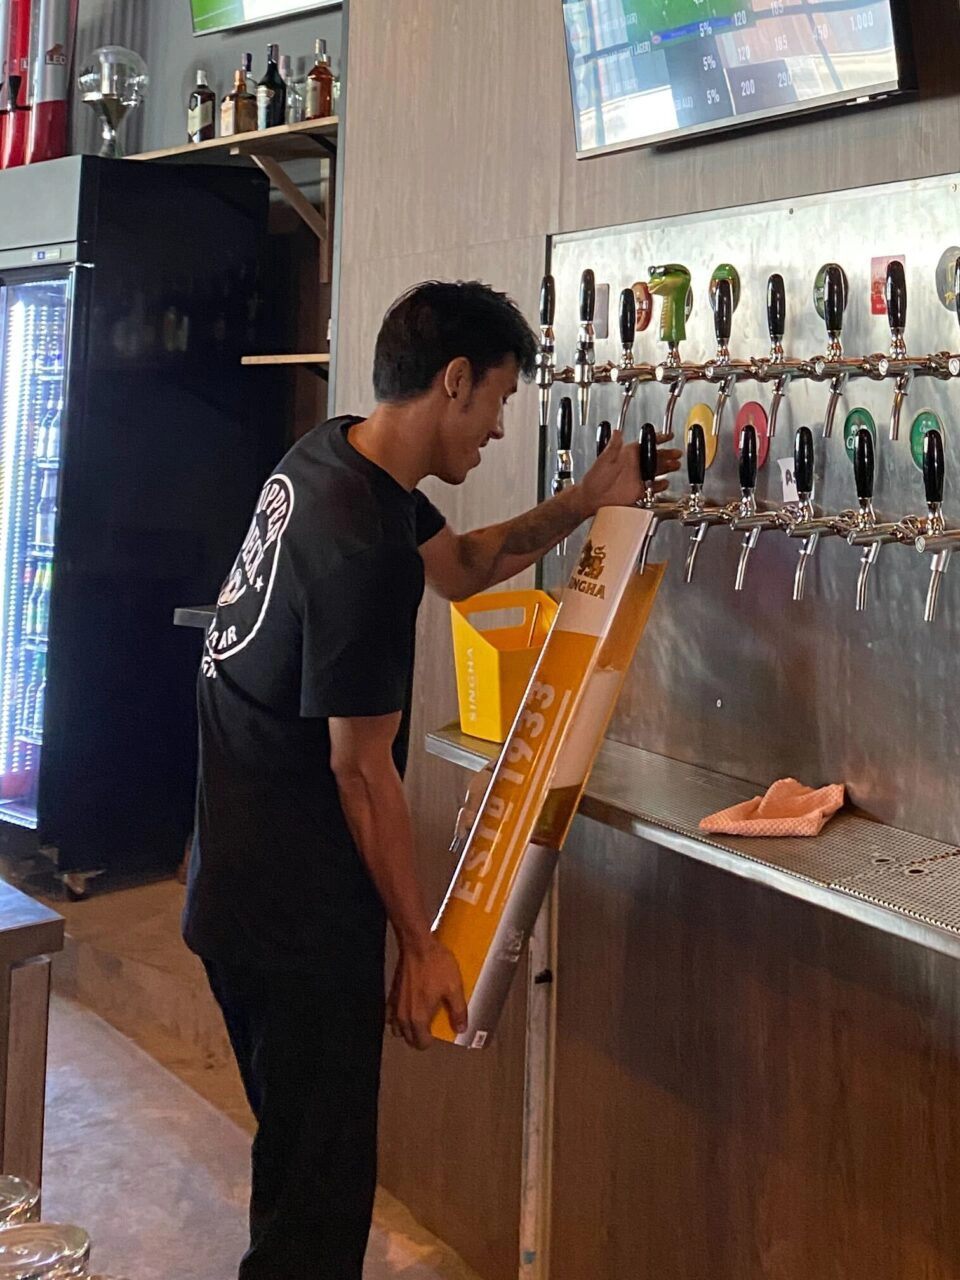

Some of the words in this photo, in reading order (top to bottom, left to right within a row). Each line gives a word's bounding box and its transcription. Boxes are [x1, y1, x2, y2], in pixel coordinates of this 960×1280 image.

[734, 10, 747, 26] 120
[699, 22, 712, 38] 5%
[702, 55, 716, 71] 5%
[740, 79, 755, 97] 200
[706, 88, 720, 105] 5%
[497, 680, 555, 785] 1933
